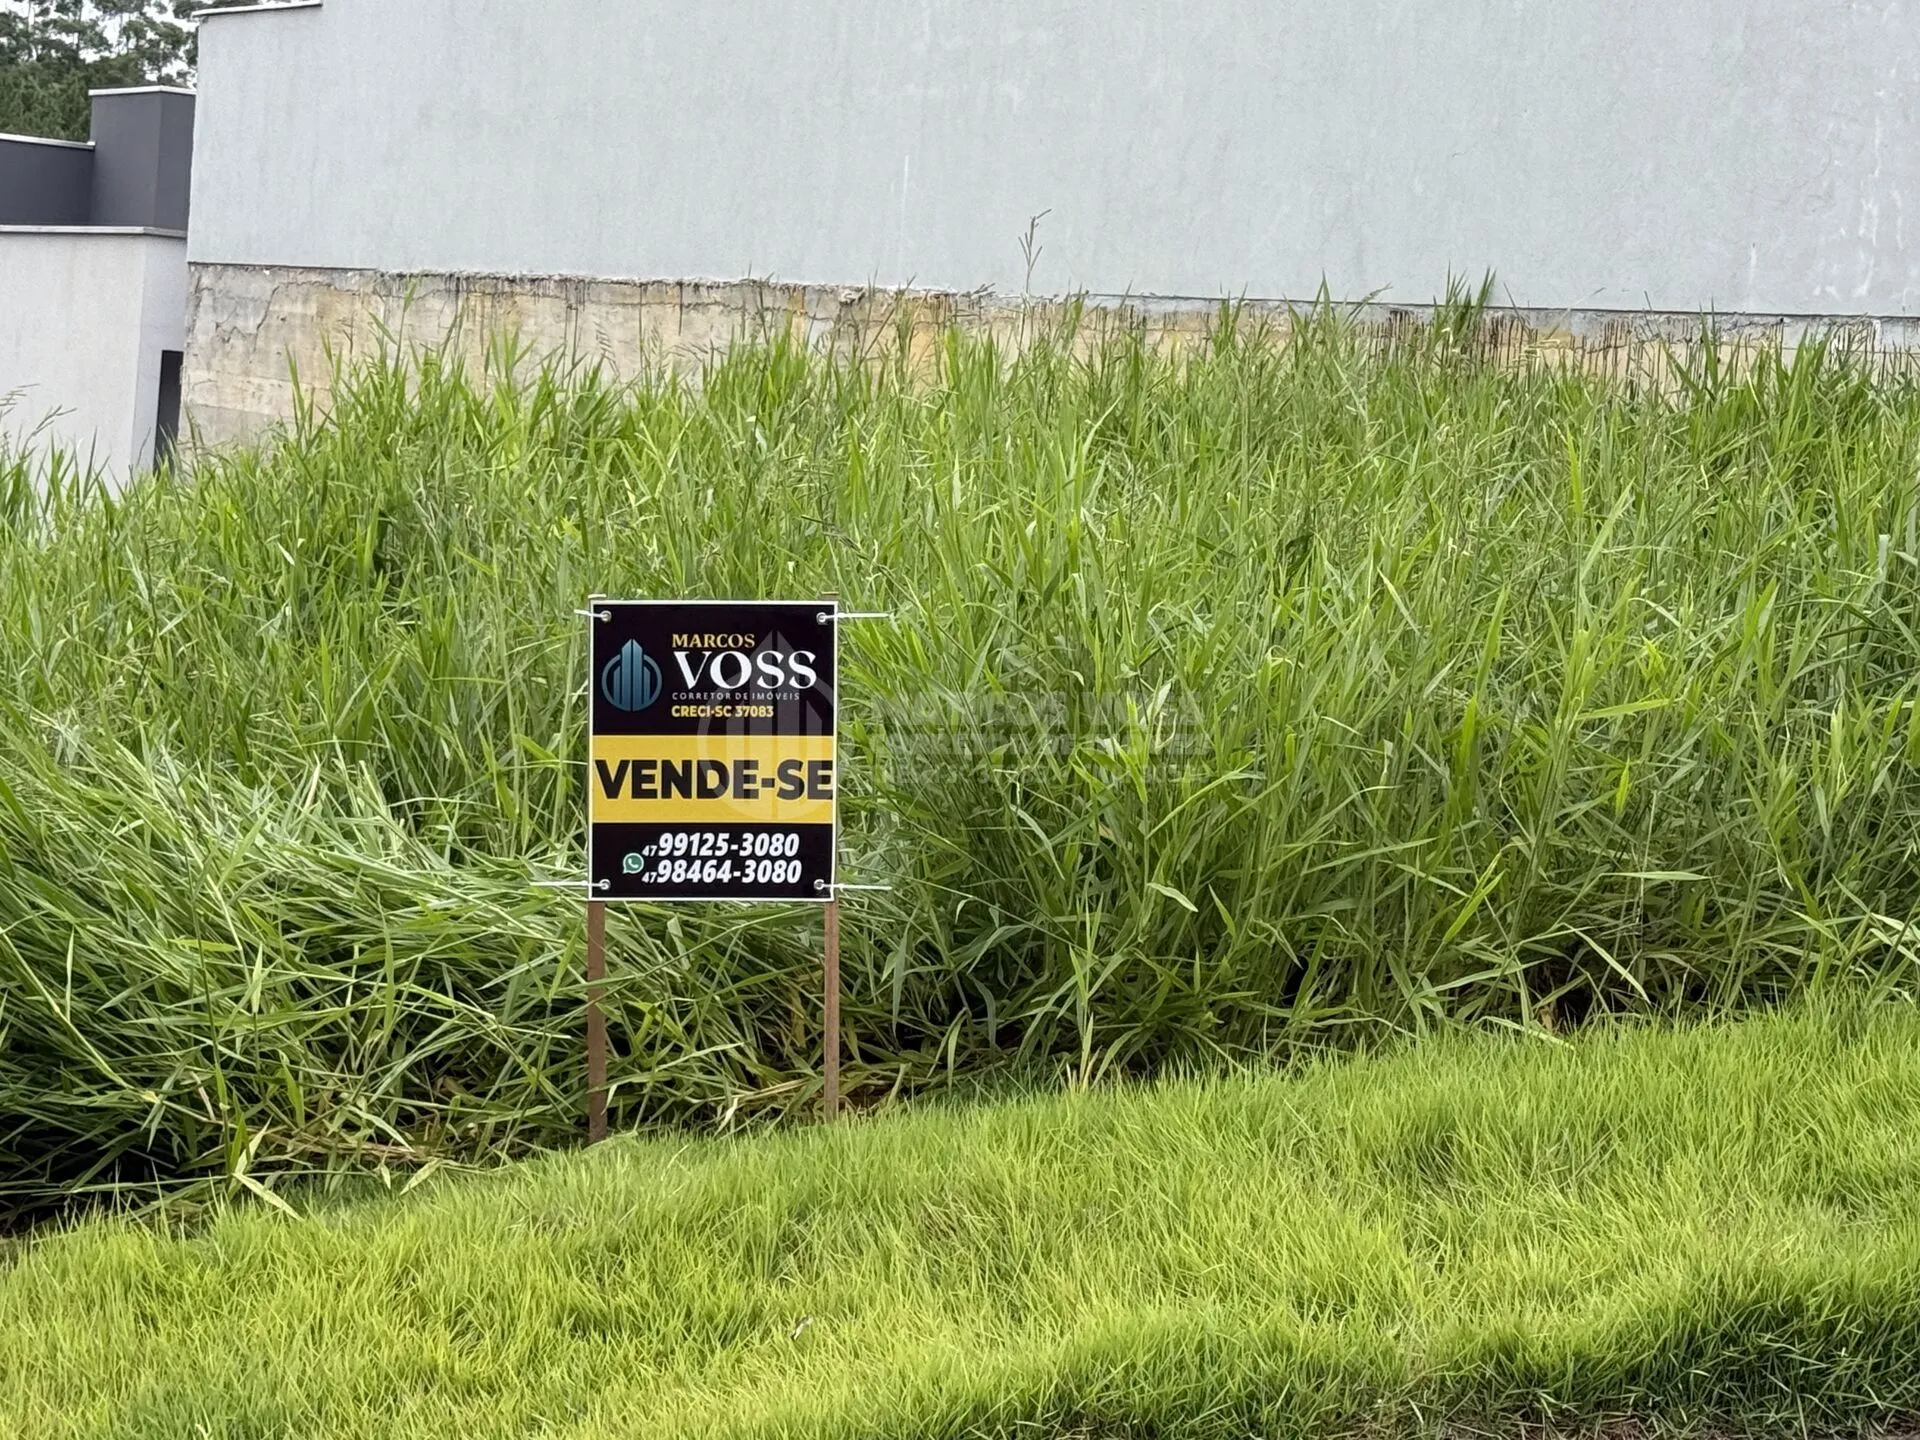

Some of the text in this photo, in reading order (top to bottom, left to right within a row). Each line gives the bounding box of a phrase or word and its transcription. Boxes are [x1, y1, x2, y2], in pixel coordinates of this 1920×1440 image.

[672, 633, 755, 648] MARCOS
[673, 650, 817, 690] VOSS
[672, 690, 800, 701] CORRETOR DE IMÓVEIS
[671, 705, 774, 718] CRECI-SC 37083
[594, 758, 833, 800] VENDE-SE
